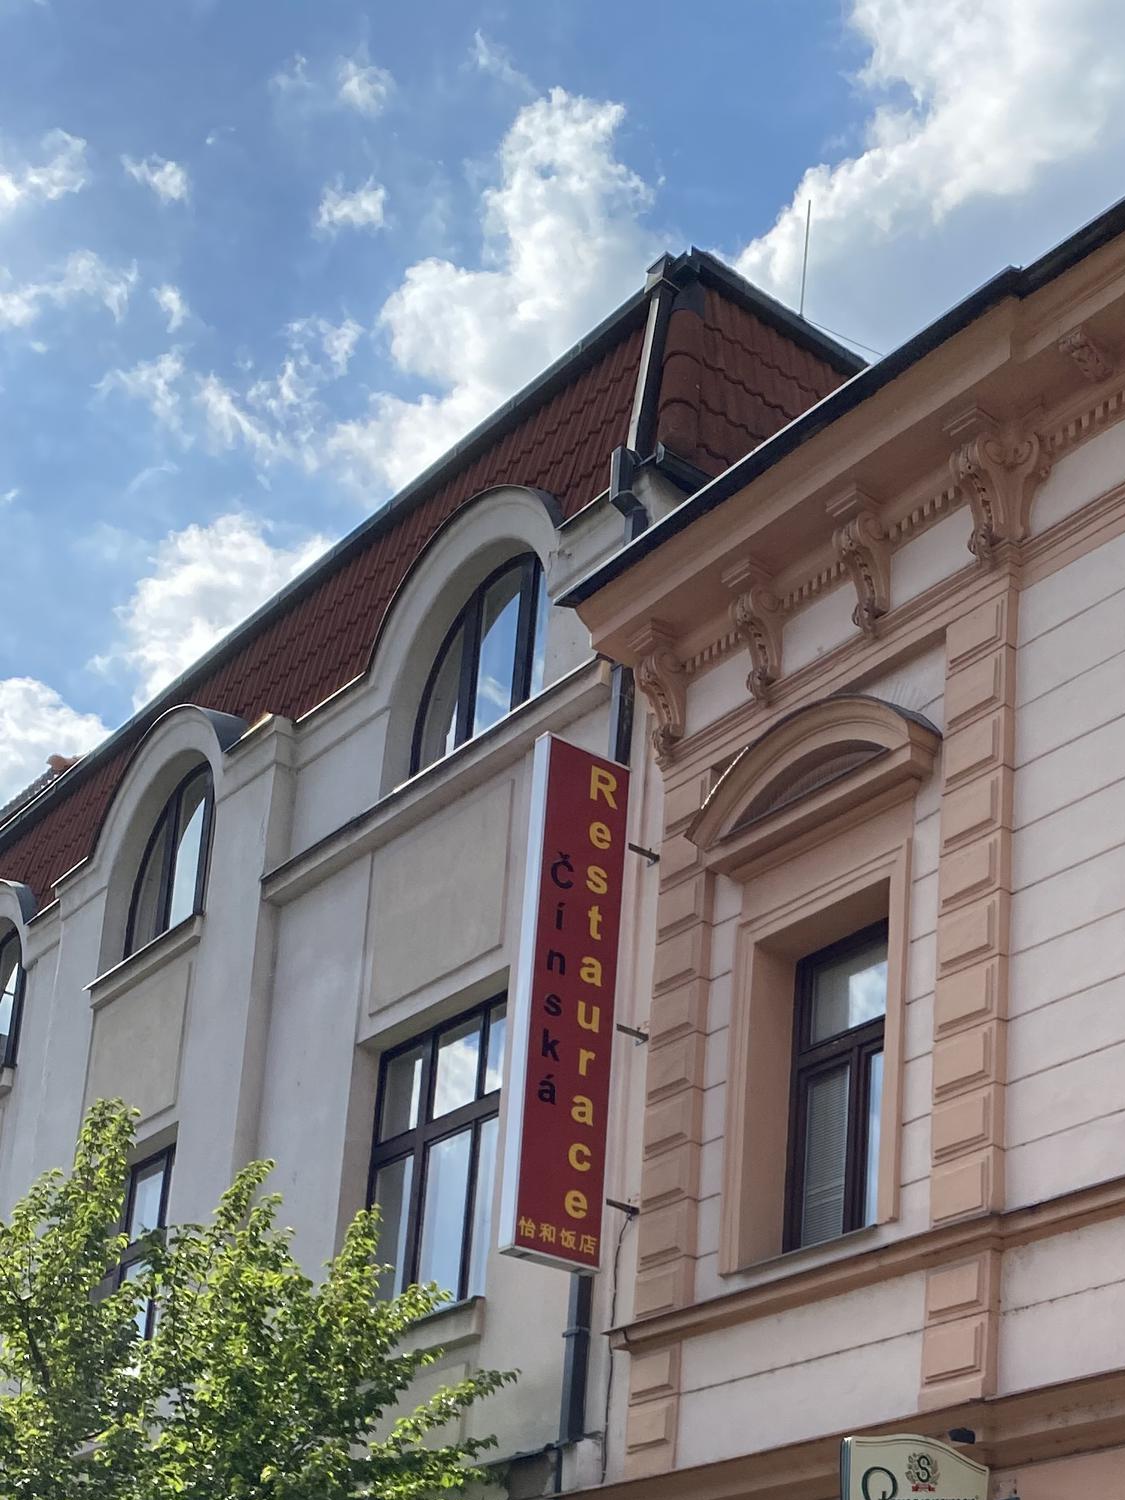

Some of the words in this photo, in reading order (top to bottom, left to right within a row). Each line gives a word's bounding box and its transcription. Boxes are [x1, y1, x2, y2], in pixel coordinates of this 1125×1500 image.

[537, 850, 575, 1106] Čínská
[563, 764, 618, 1219] Restaurace
[518, 1215, 597, 1256] 怡和饭店
